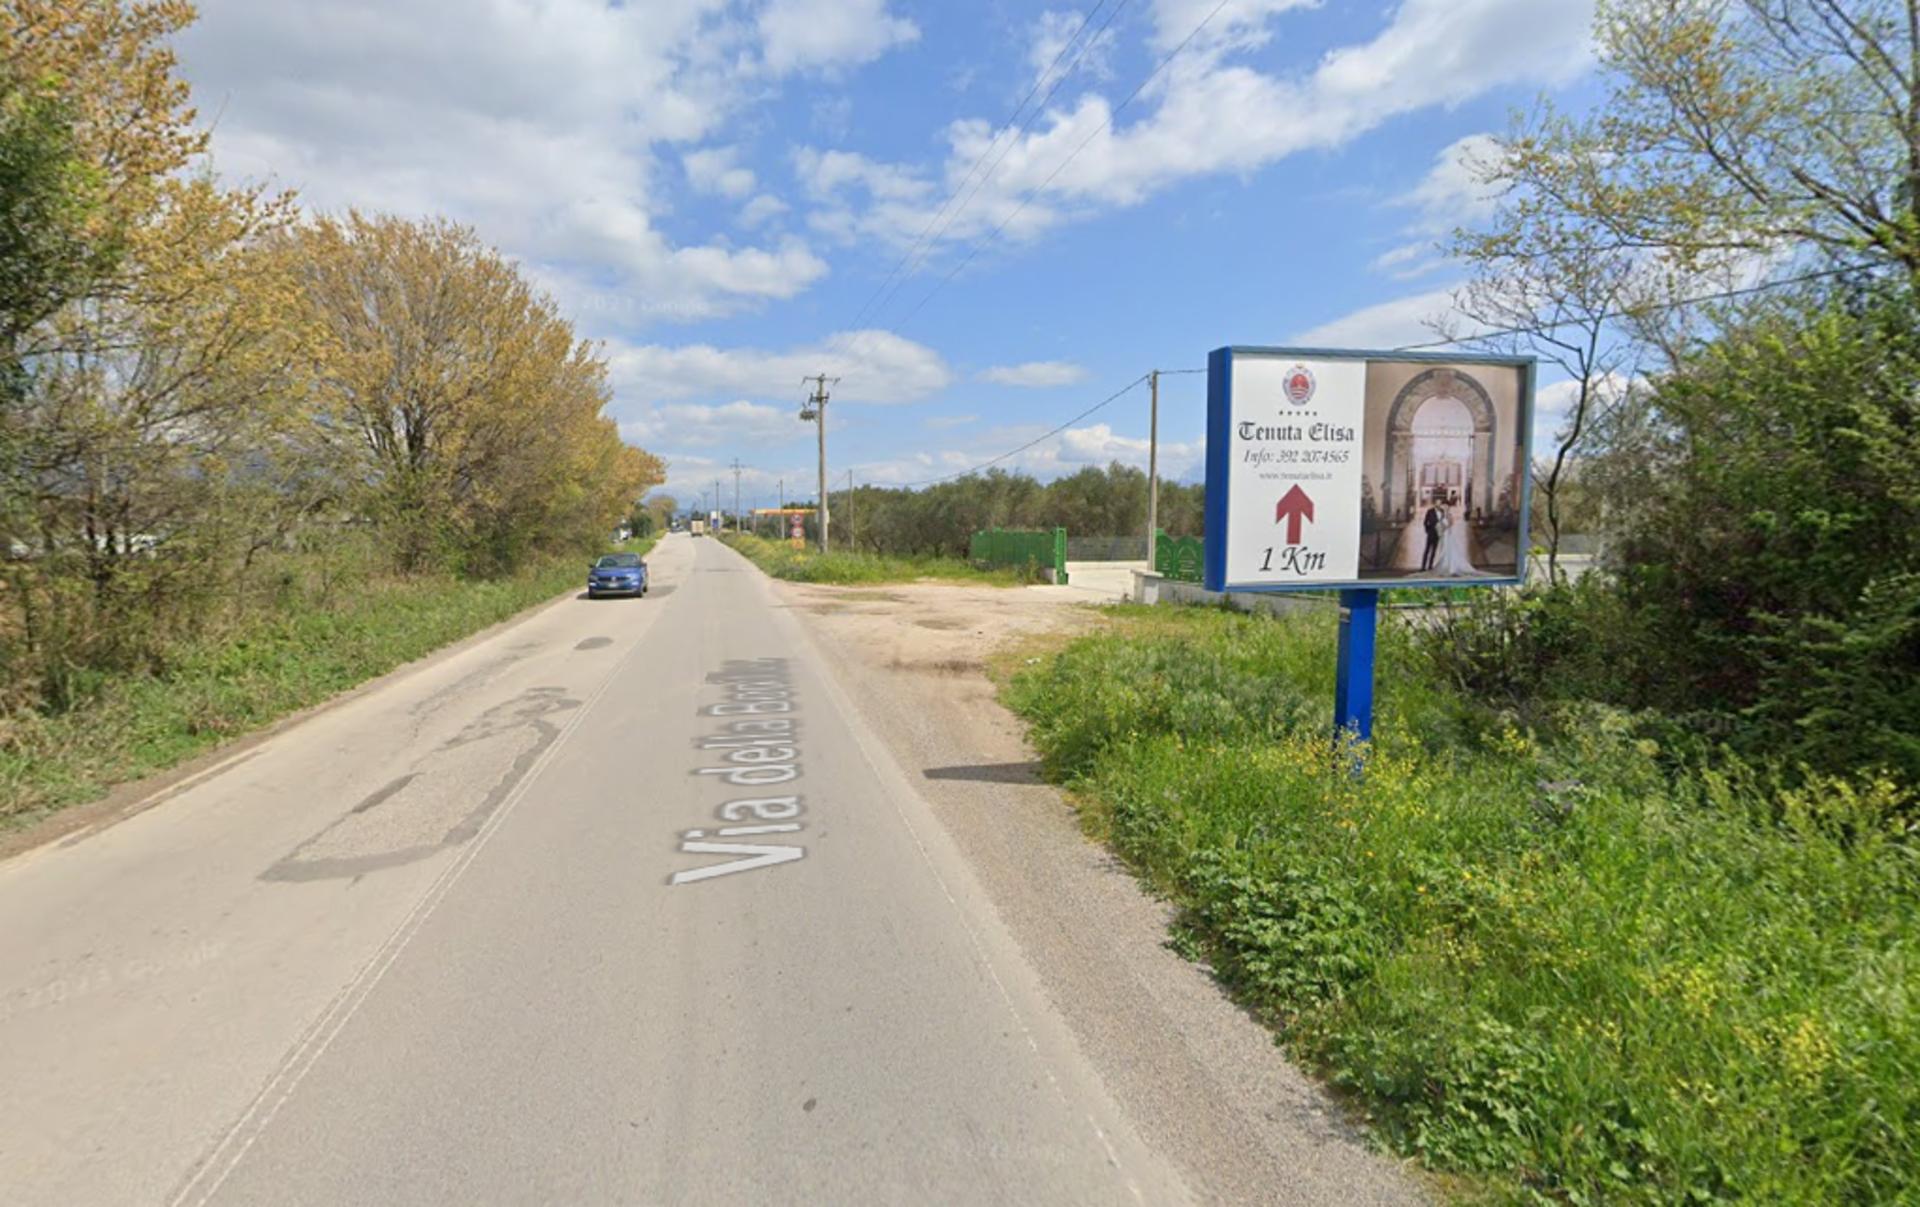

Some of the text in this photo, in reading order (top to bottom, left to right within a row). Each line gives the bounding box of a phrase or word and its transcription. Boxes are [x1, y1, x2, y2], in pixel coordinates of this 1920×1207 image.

[1238, 421, 1355, 441] Tenuta Elisa
[1244, 448, 1350, 468] Info: 392 2074565
[1259, 546, 1326, 576] 1 Km
